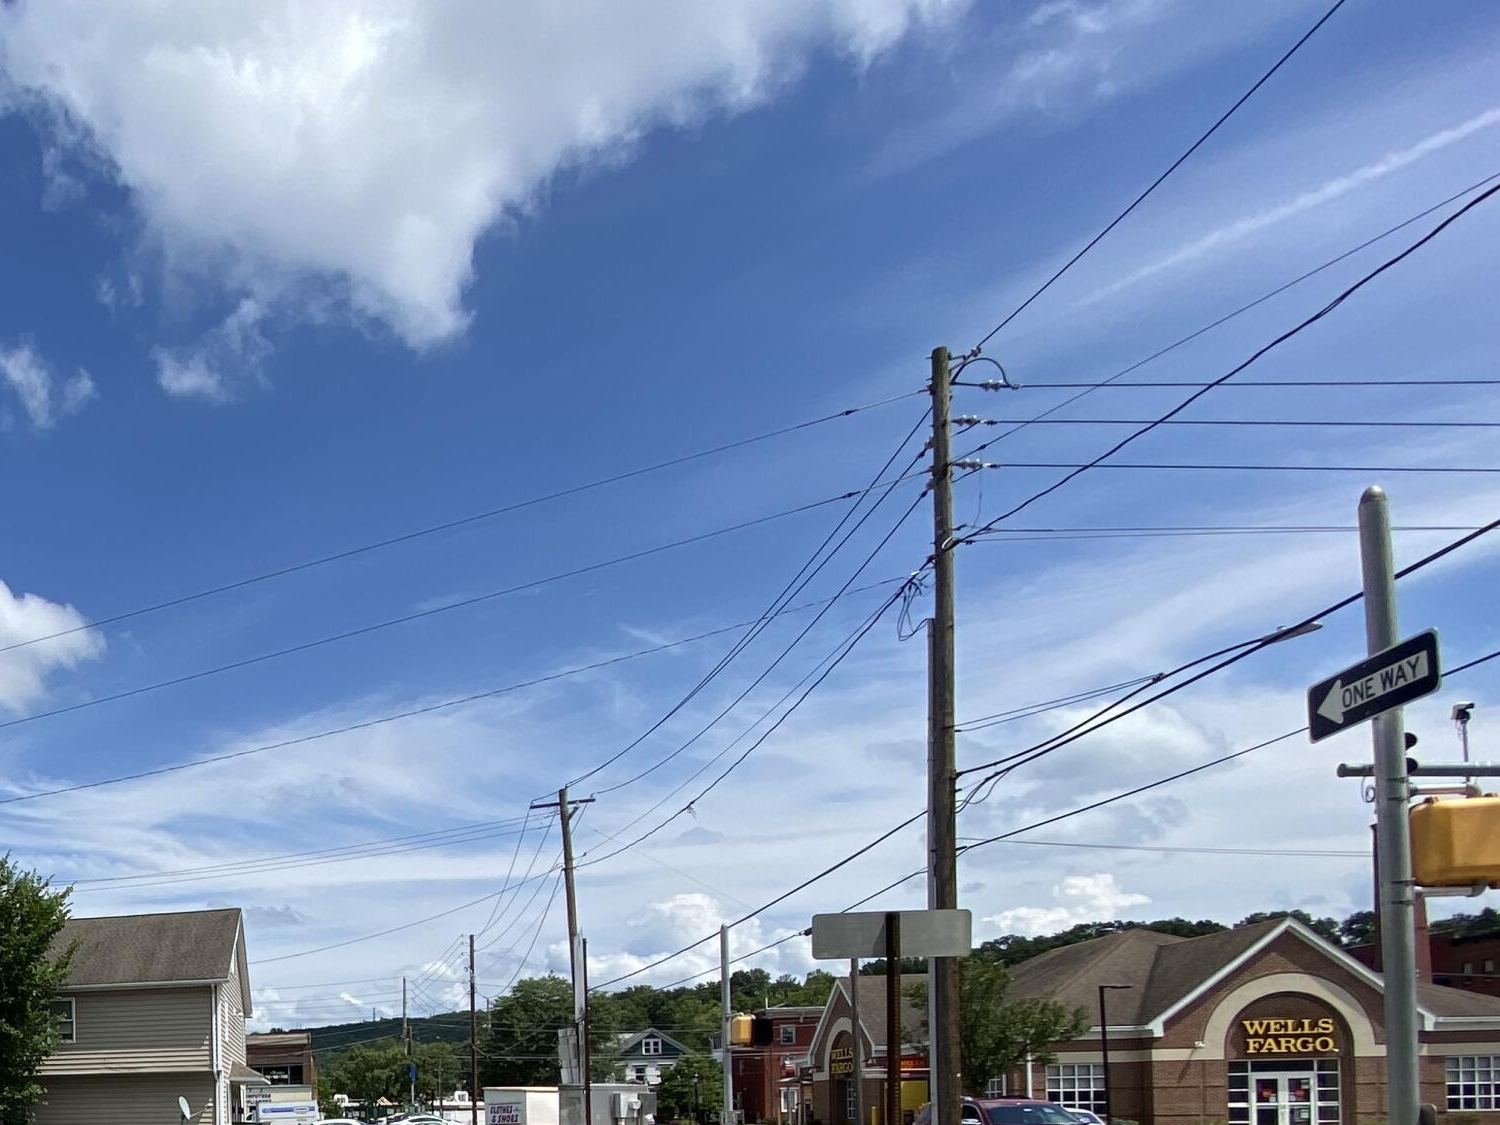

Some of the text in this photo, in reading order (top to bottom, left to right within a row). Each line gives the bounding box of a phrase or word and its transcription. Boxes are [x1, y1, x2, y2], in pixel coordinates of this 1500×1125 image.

[1342, 656, 1420, 708] ONE WAY
[1242, 1018, 1334, 1035] WELLS
[1246, 1037, 1334, 1053] FARGO
[490, 1105, 513, 1115] CLOTHES
[498, 1114, 519, 1123] SHOES
